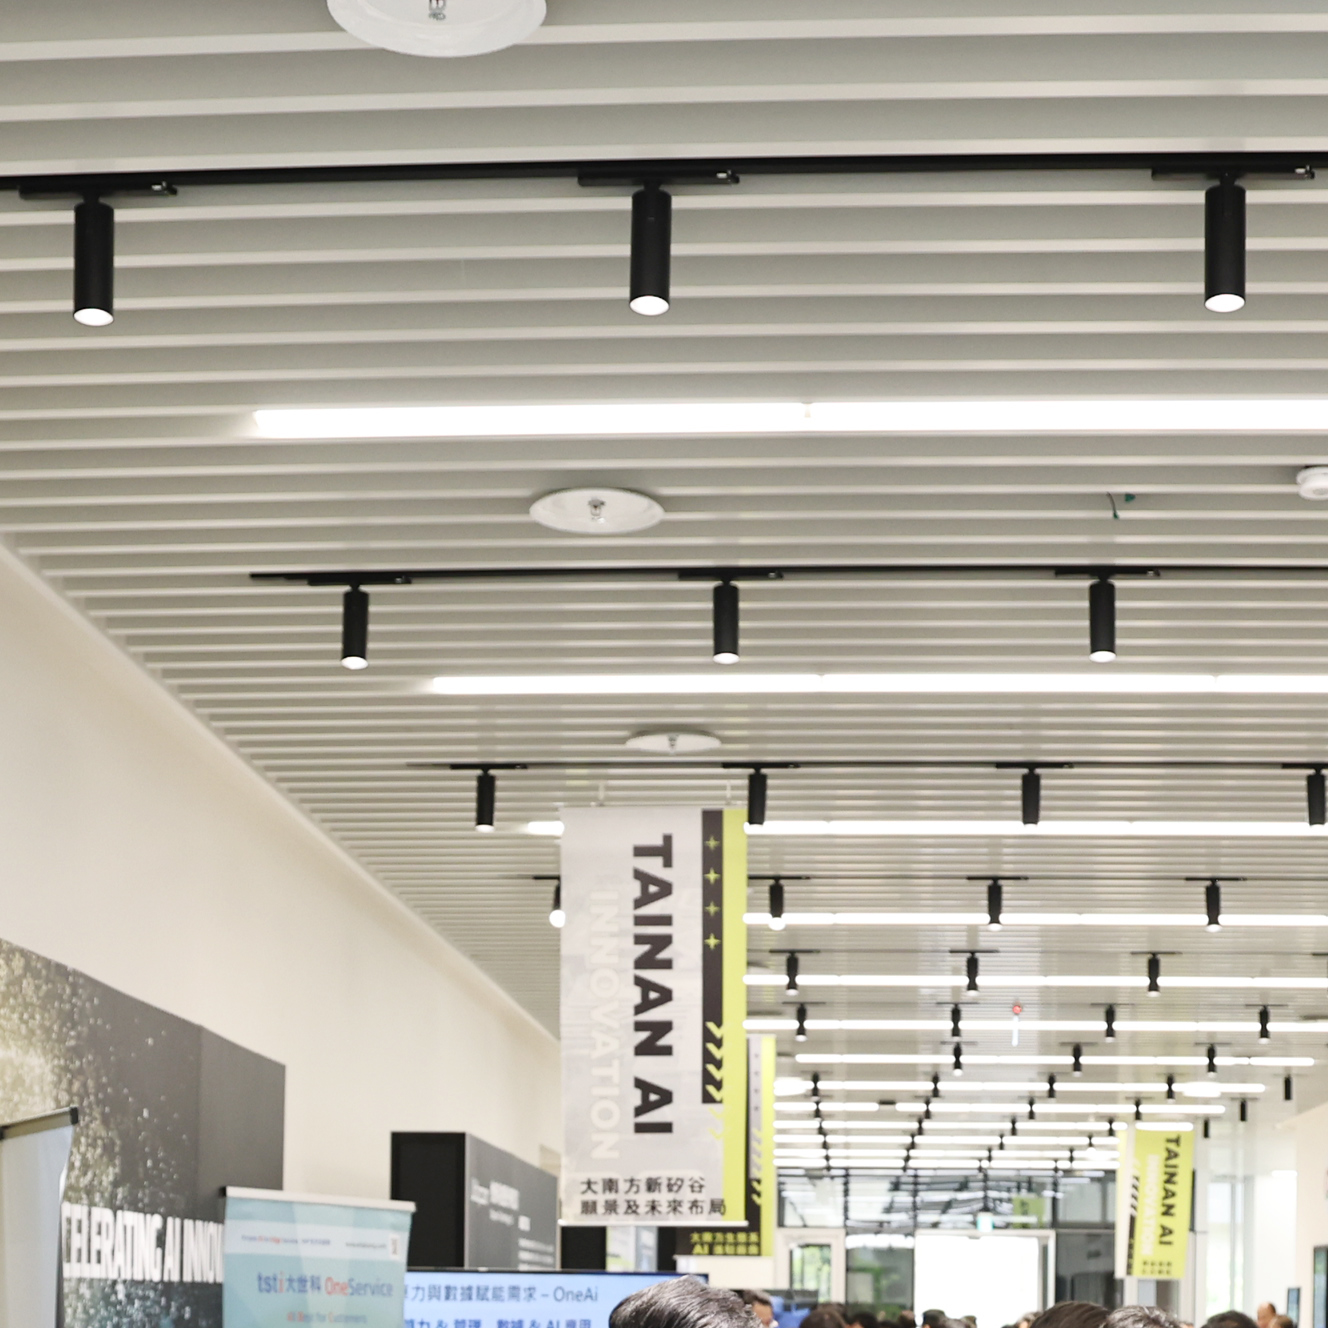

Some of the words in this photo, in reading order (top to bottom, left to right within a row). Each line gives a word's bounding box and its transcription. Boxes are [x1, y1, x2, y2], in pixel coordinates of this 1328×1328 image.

[633, 833, 673, 1056] TAINAN
[589, 891, 620, 1160] INNOVATION
[633, 1077, 673, 1134] AI
[580, 1177, 705, 1194] 大南方新矽谷
[1162, 1134, 1180, 1217] TAINAN
[580, 1198, 726, 1216] 願景及未來布局
[164, 1217, 181, 1282] AI
[1159, 1225, 1174, 1246] AI
[258, 1272, 320, 1293] tsti大世科
[325, 1277, 393, 1296] OneService
[404, 1285, 537, 1302] 力與數據賦能需求
[553, 1286, 599, 1302] OneAi
